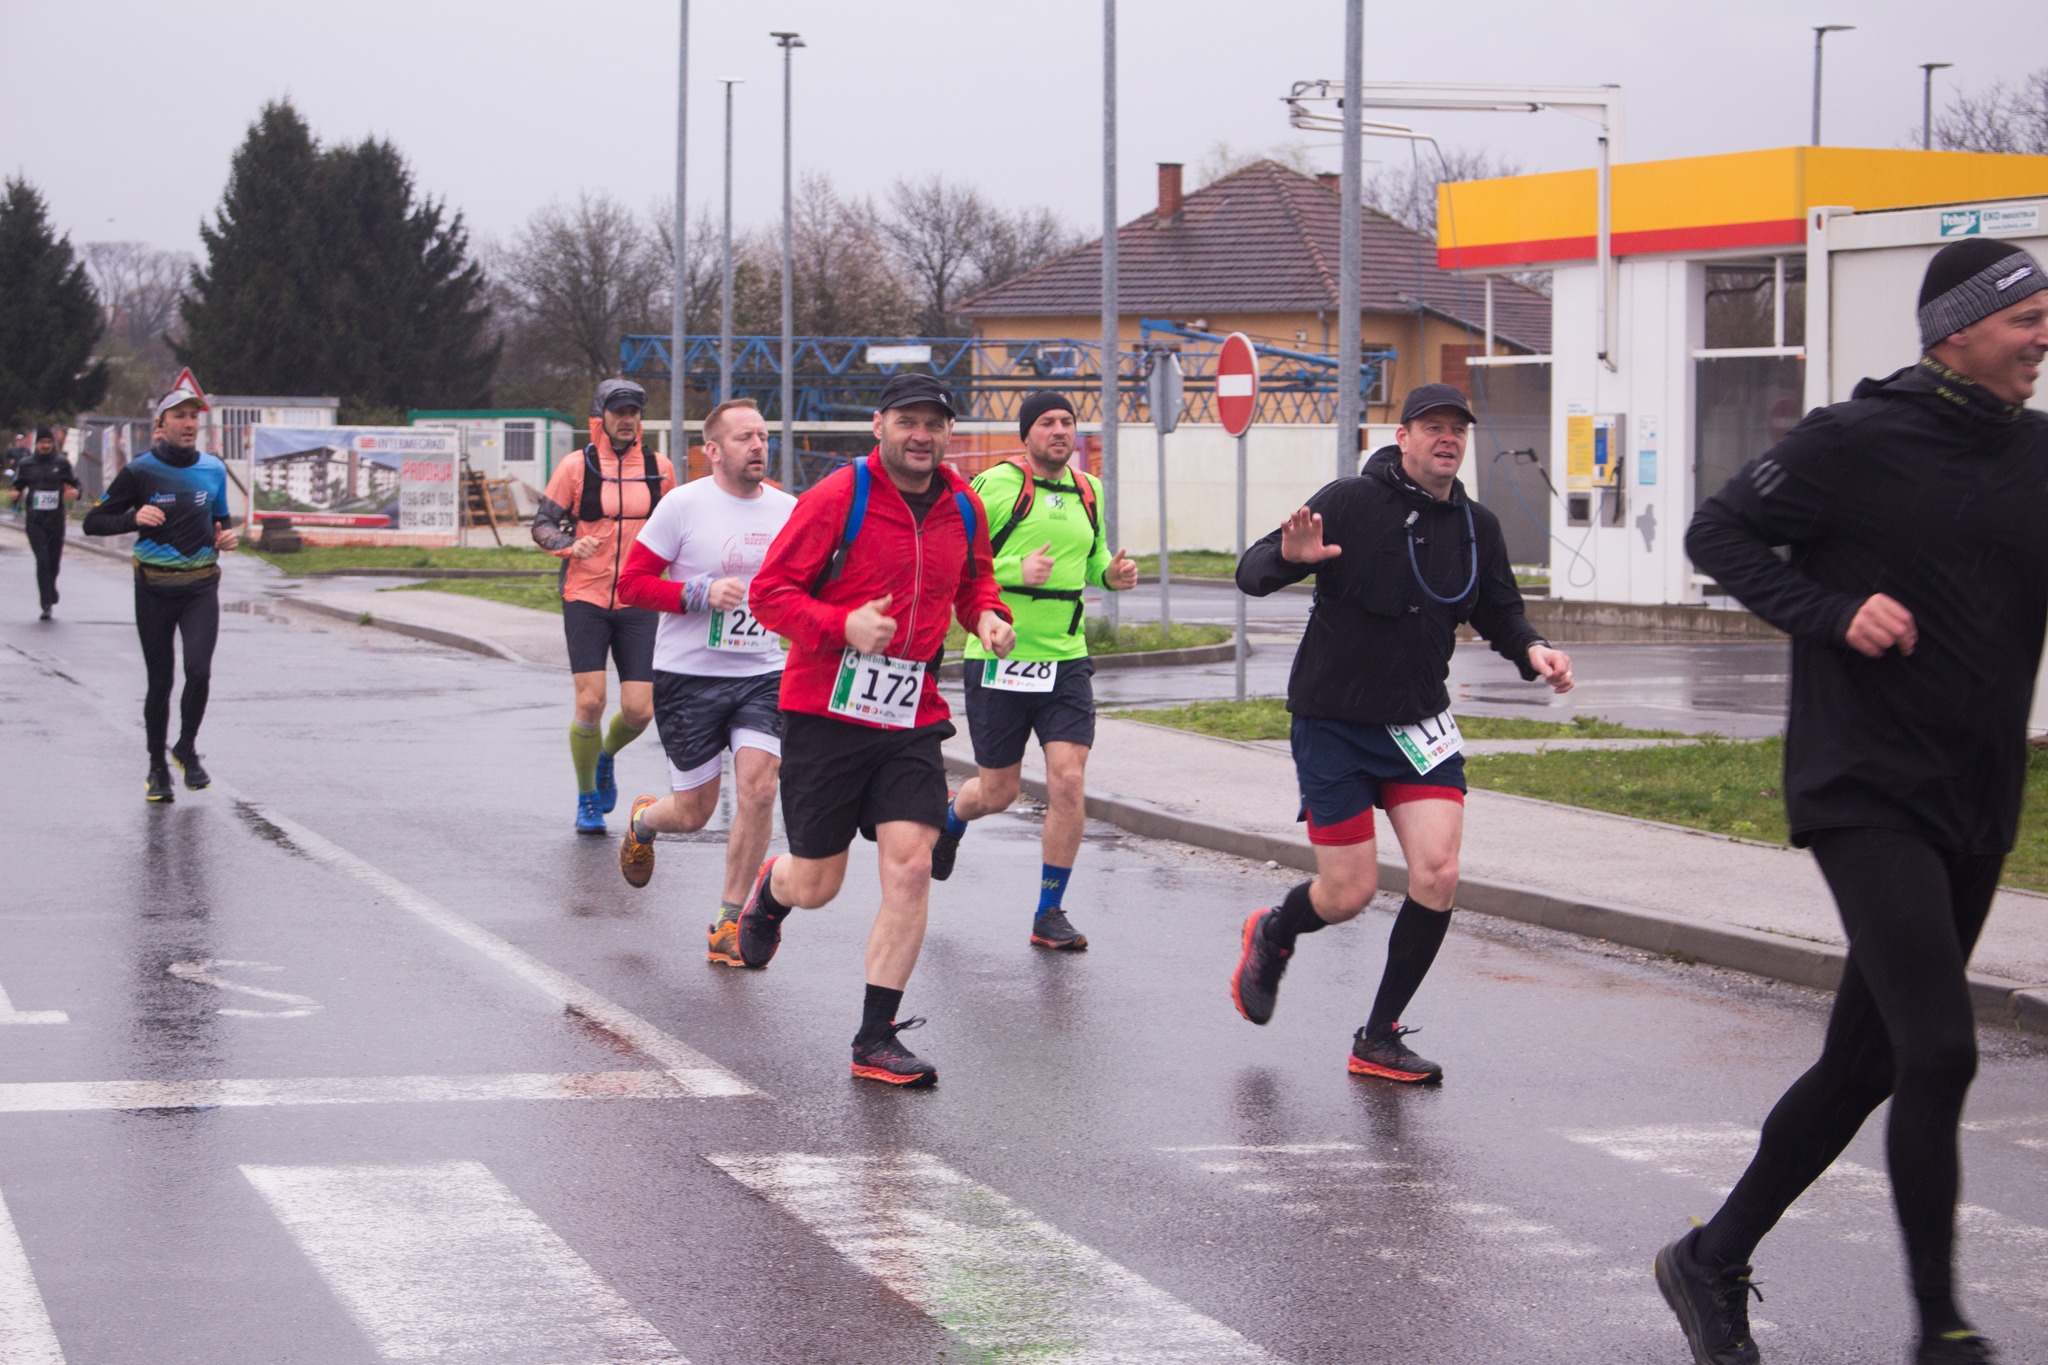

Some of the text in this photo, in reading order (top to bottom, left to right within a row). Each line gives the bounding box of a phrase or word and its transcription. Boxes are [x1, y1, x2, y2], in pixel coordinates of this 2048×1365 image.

[1983, 211, 2000, 221] EKO
[378, 437, 446, 450] INTERMEGRAD
[402, 461, 453, 482] PRODAJA
[730, 609, 767, 637] 22
[1004, 660, 1052, 680] 228
[861, 667, 918, 708] 172
